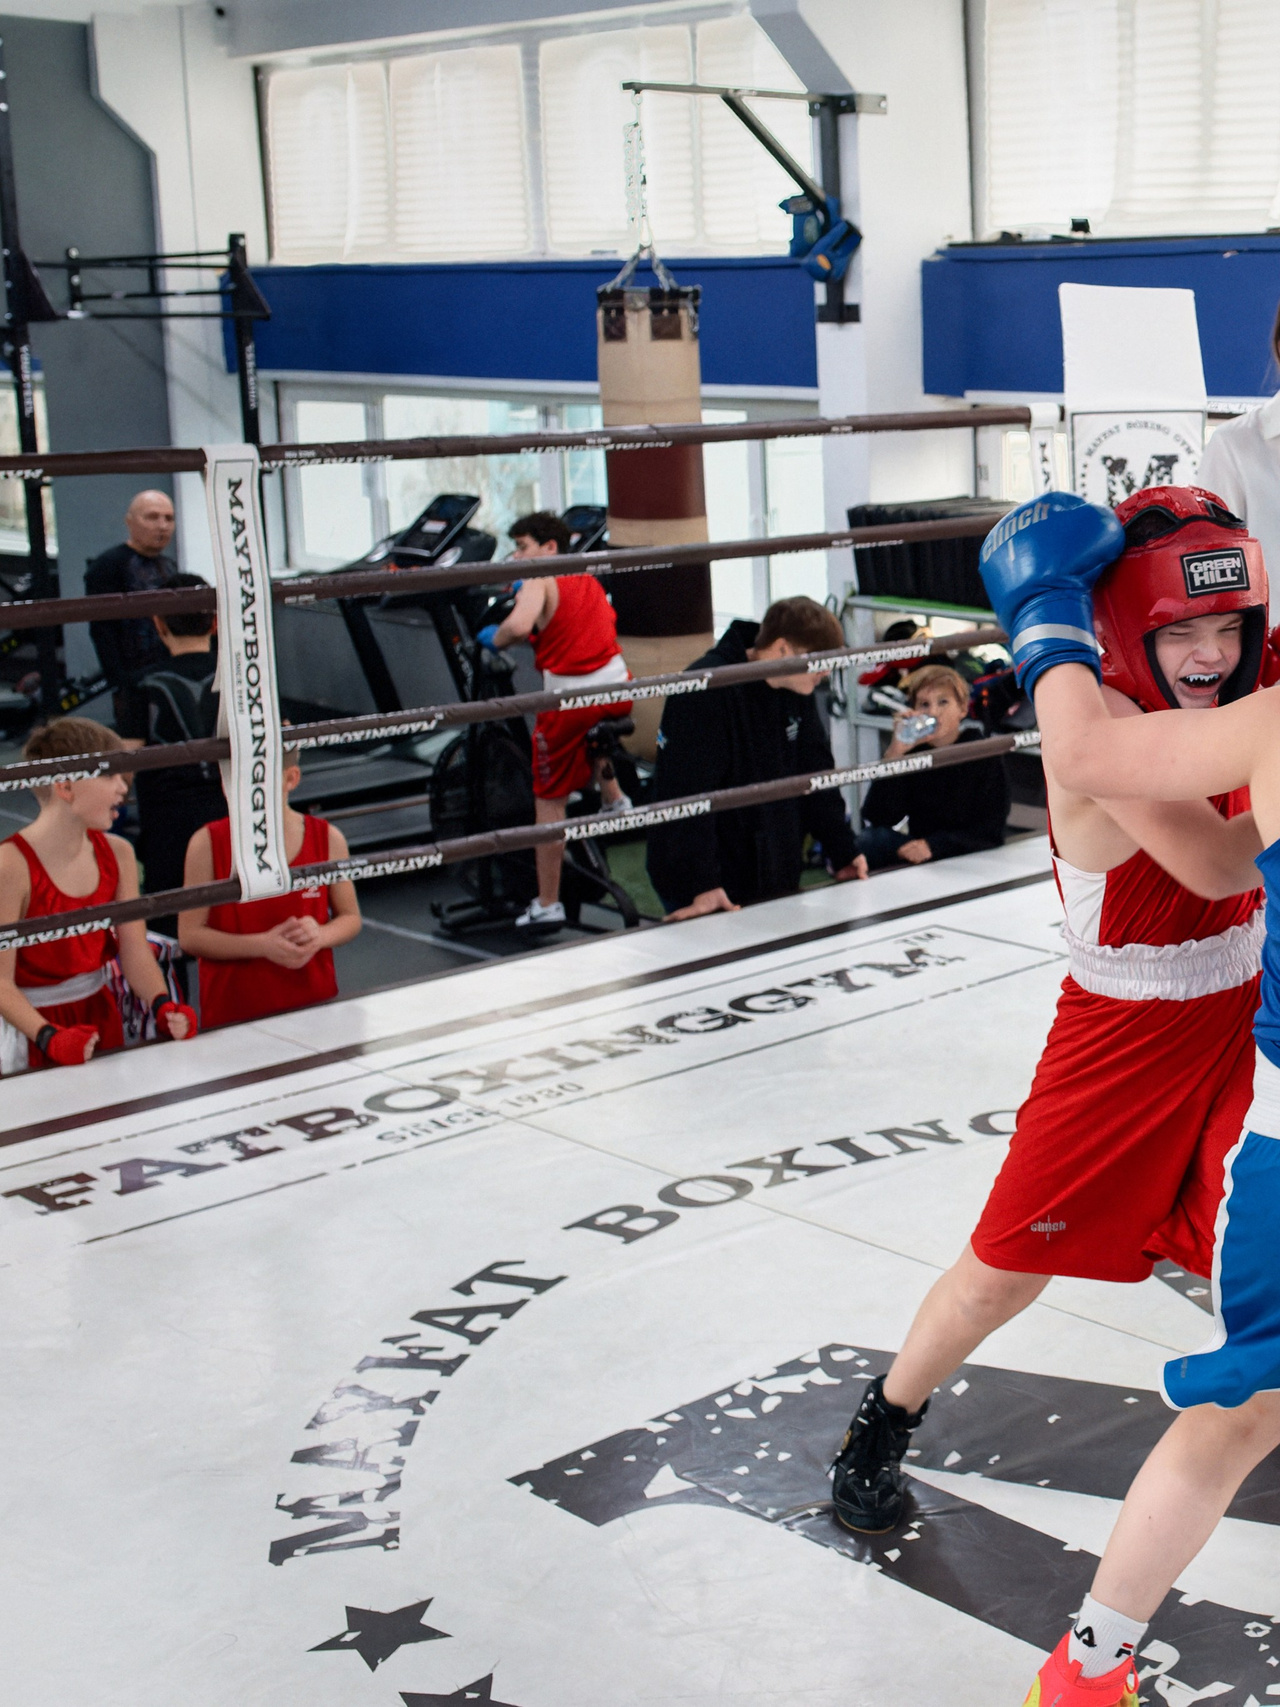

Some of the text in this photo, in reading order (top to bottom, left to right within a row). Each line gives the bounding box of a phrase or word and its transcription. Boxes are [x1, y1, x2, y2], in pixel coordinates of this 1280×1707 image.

[1189, 557, 1242, 578] GREEN
[1193, 570, 1239, 587] HILL
[225, 478, 273, 874] MAYFATBOXINGGYM
[559, 676, 710, 711] MAYFATBOXINGGYM
